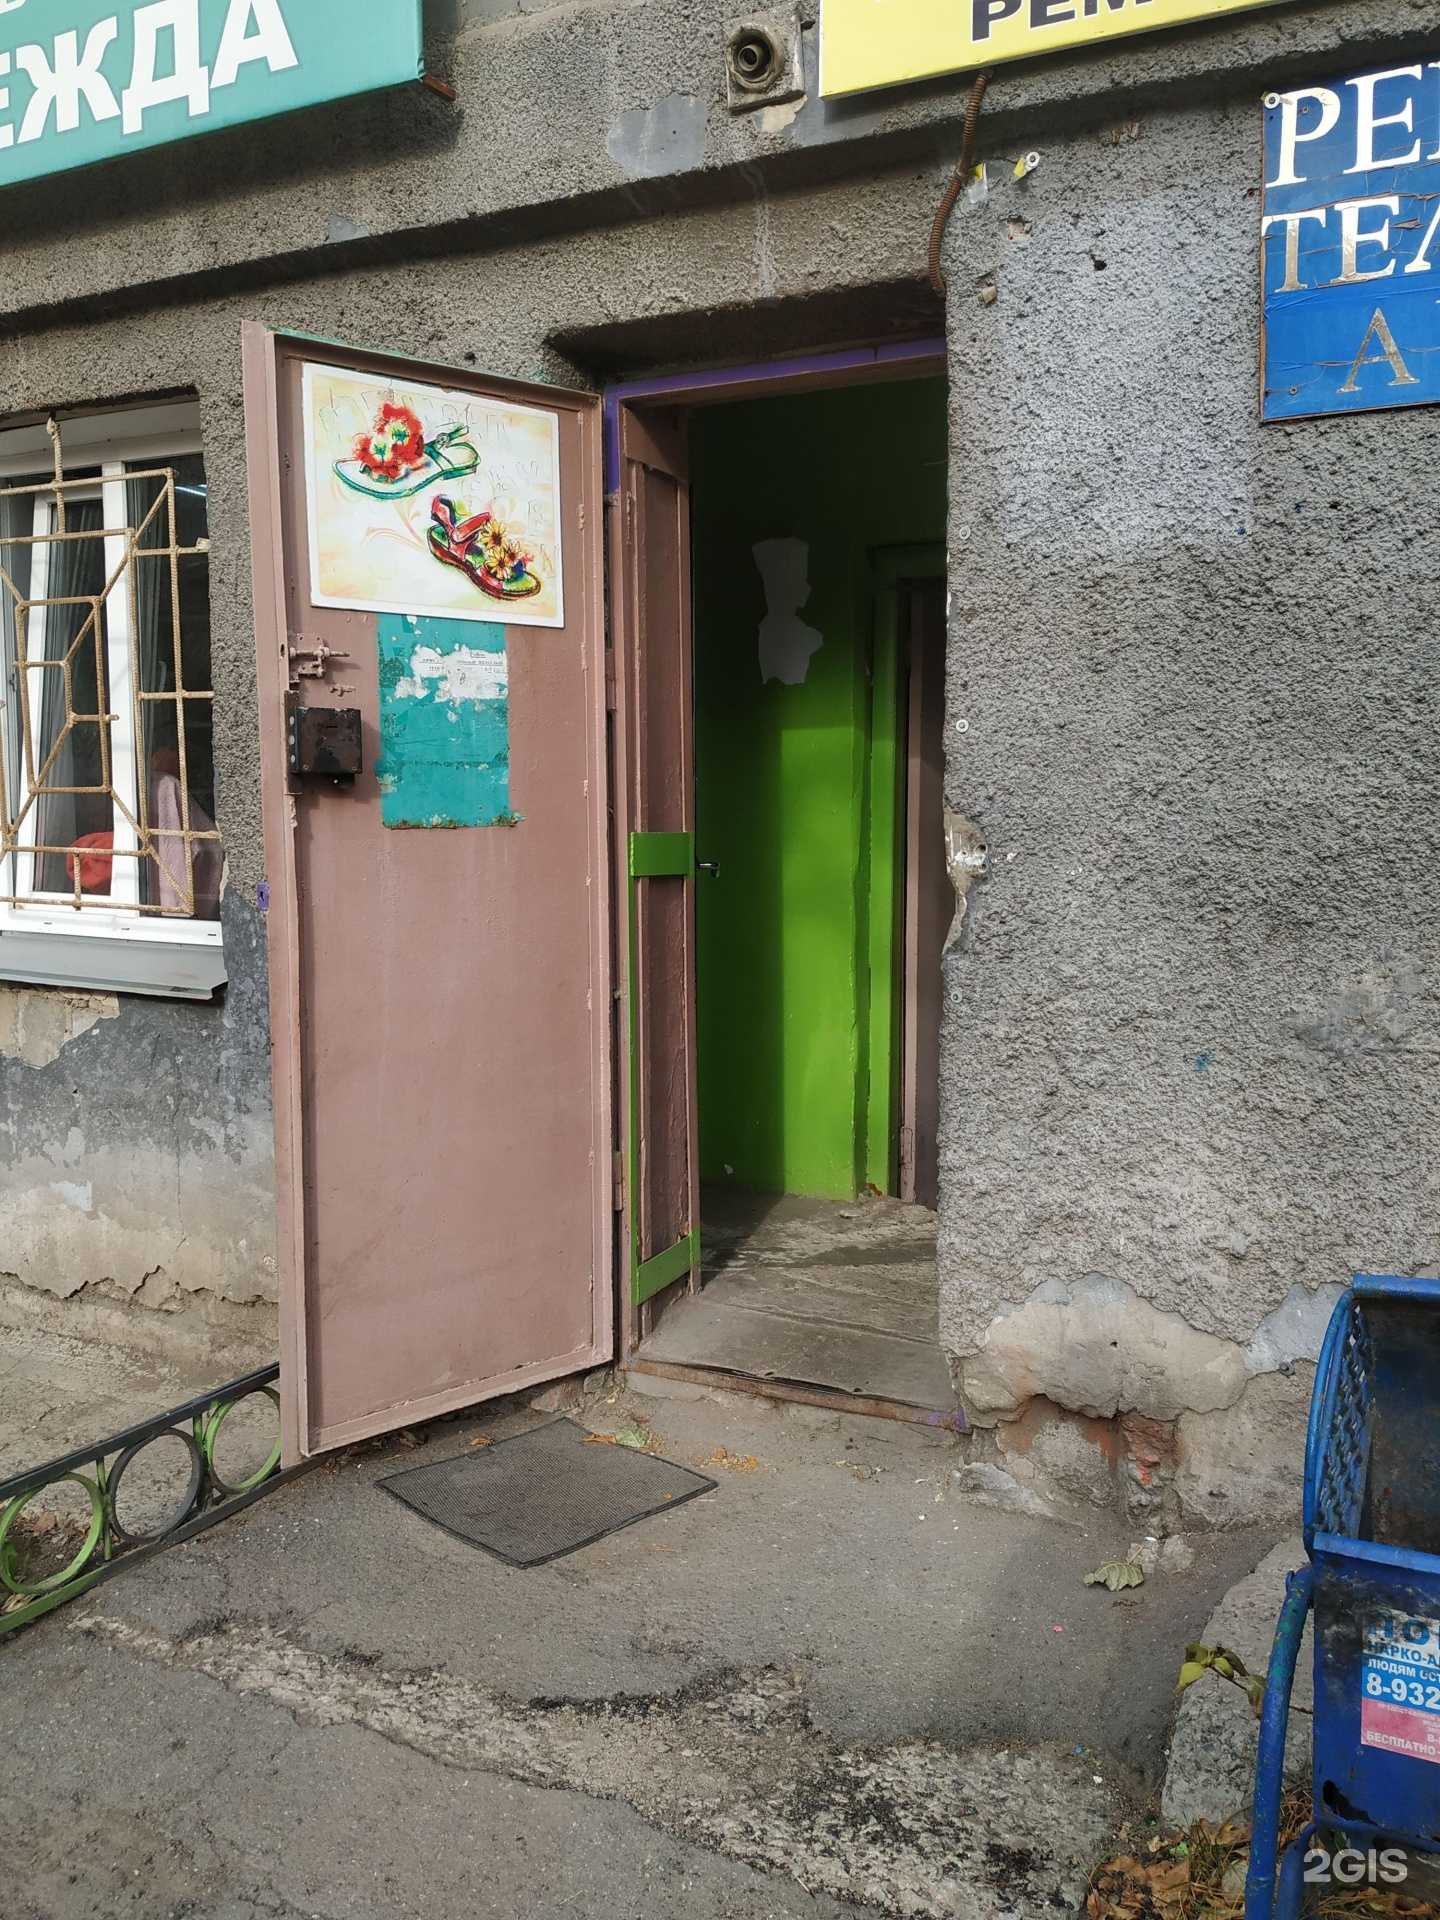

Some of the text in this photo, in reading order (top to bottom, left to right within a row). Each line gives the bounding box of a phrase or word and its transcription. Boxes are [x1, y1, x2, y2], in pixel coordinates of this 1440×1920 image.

[971, 0, 1150, 42] РЕ
[0, 0, 299, 150] ЖДА
[1367, 1640, 1440, 1668] НАРКО-А
[1367, 1672, 1440, 1710] 8-932
[1366, 1730, 1436, 1756] БЕСПЛАТНО
